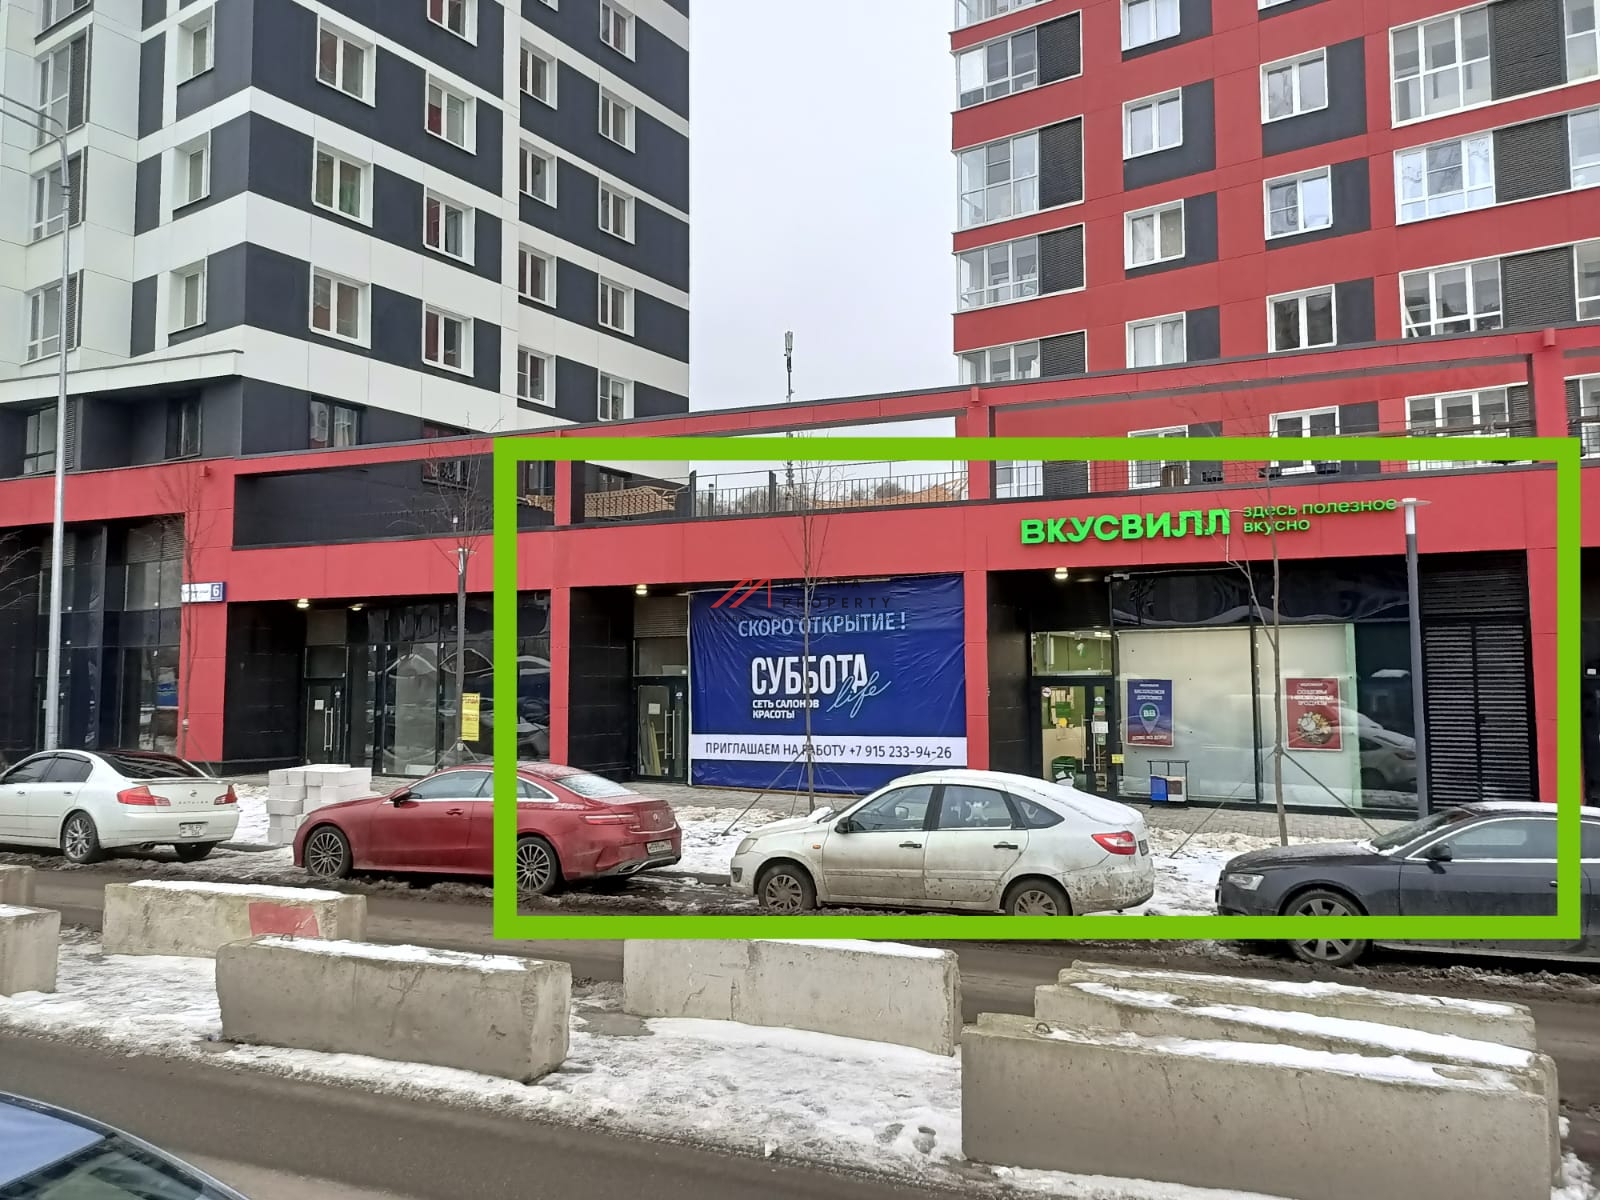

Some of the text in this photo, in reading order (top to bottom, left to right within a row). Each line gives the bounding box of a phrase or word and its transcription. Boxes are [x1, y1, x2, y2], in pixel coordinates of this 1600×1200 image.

[1302, 498, 1398, 514] полезное
[1021, 509, 1231, 545] ВКУСВИЛЛ
[1243, 519, 1311, 536] вкусно
[212, 585, 220, 597] 6
[738, 618, 794, 638] СКОРО
[751, 653, 868, 695] СУББОТА
[826, 671, 892, 718] life
[752, 699, 774, 709] СЕТЬ
[752, 710, 795, 719] КРАСОТЫ
[705, 742, 780, 755] ПРИГЛАШАЕМ
[783, 743, 799, 756] НА
[866, 746, 886, 758] 915
[889, 746, 952, 759] 233-94-26
